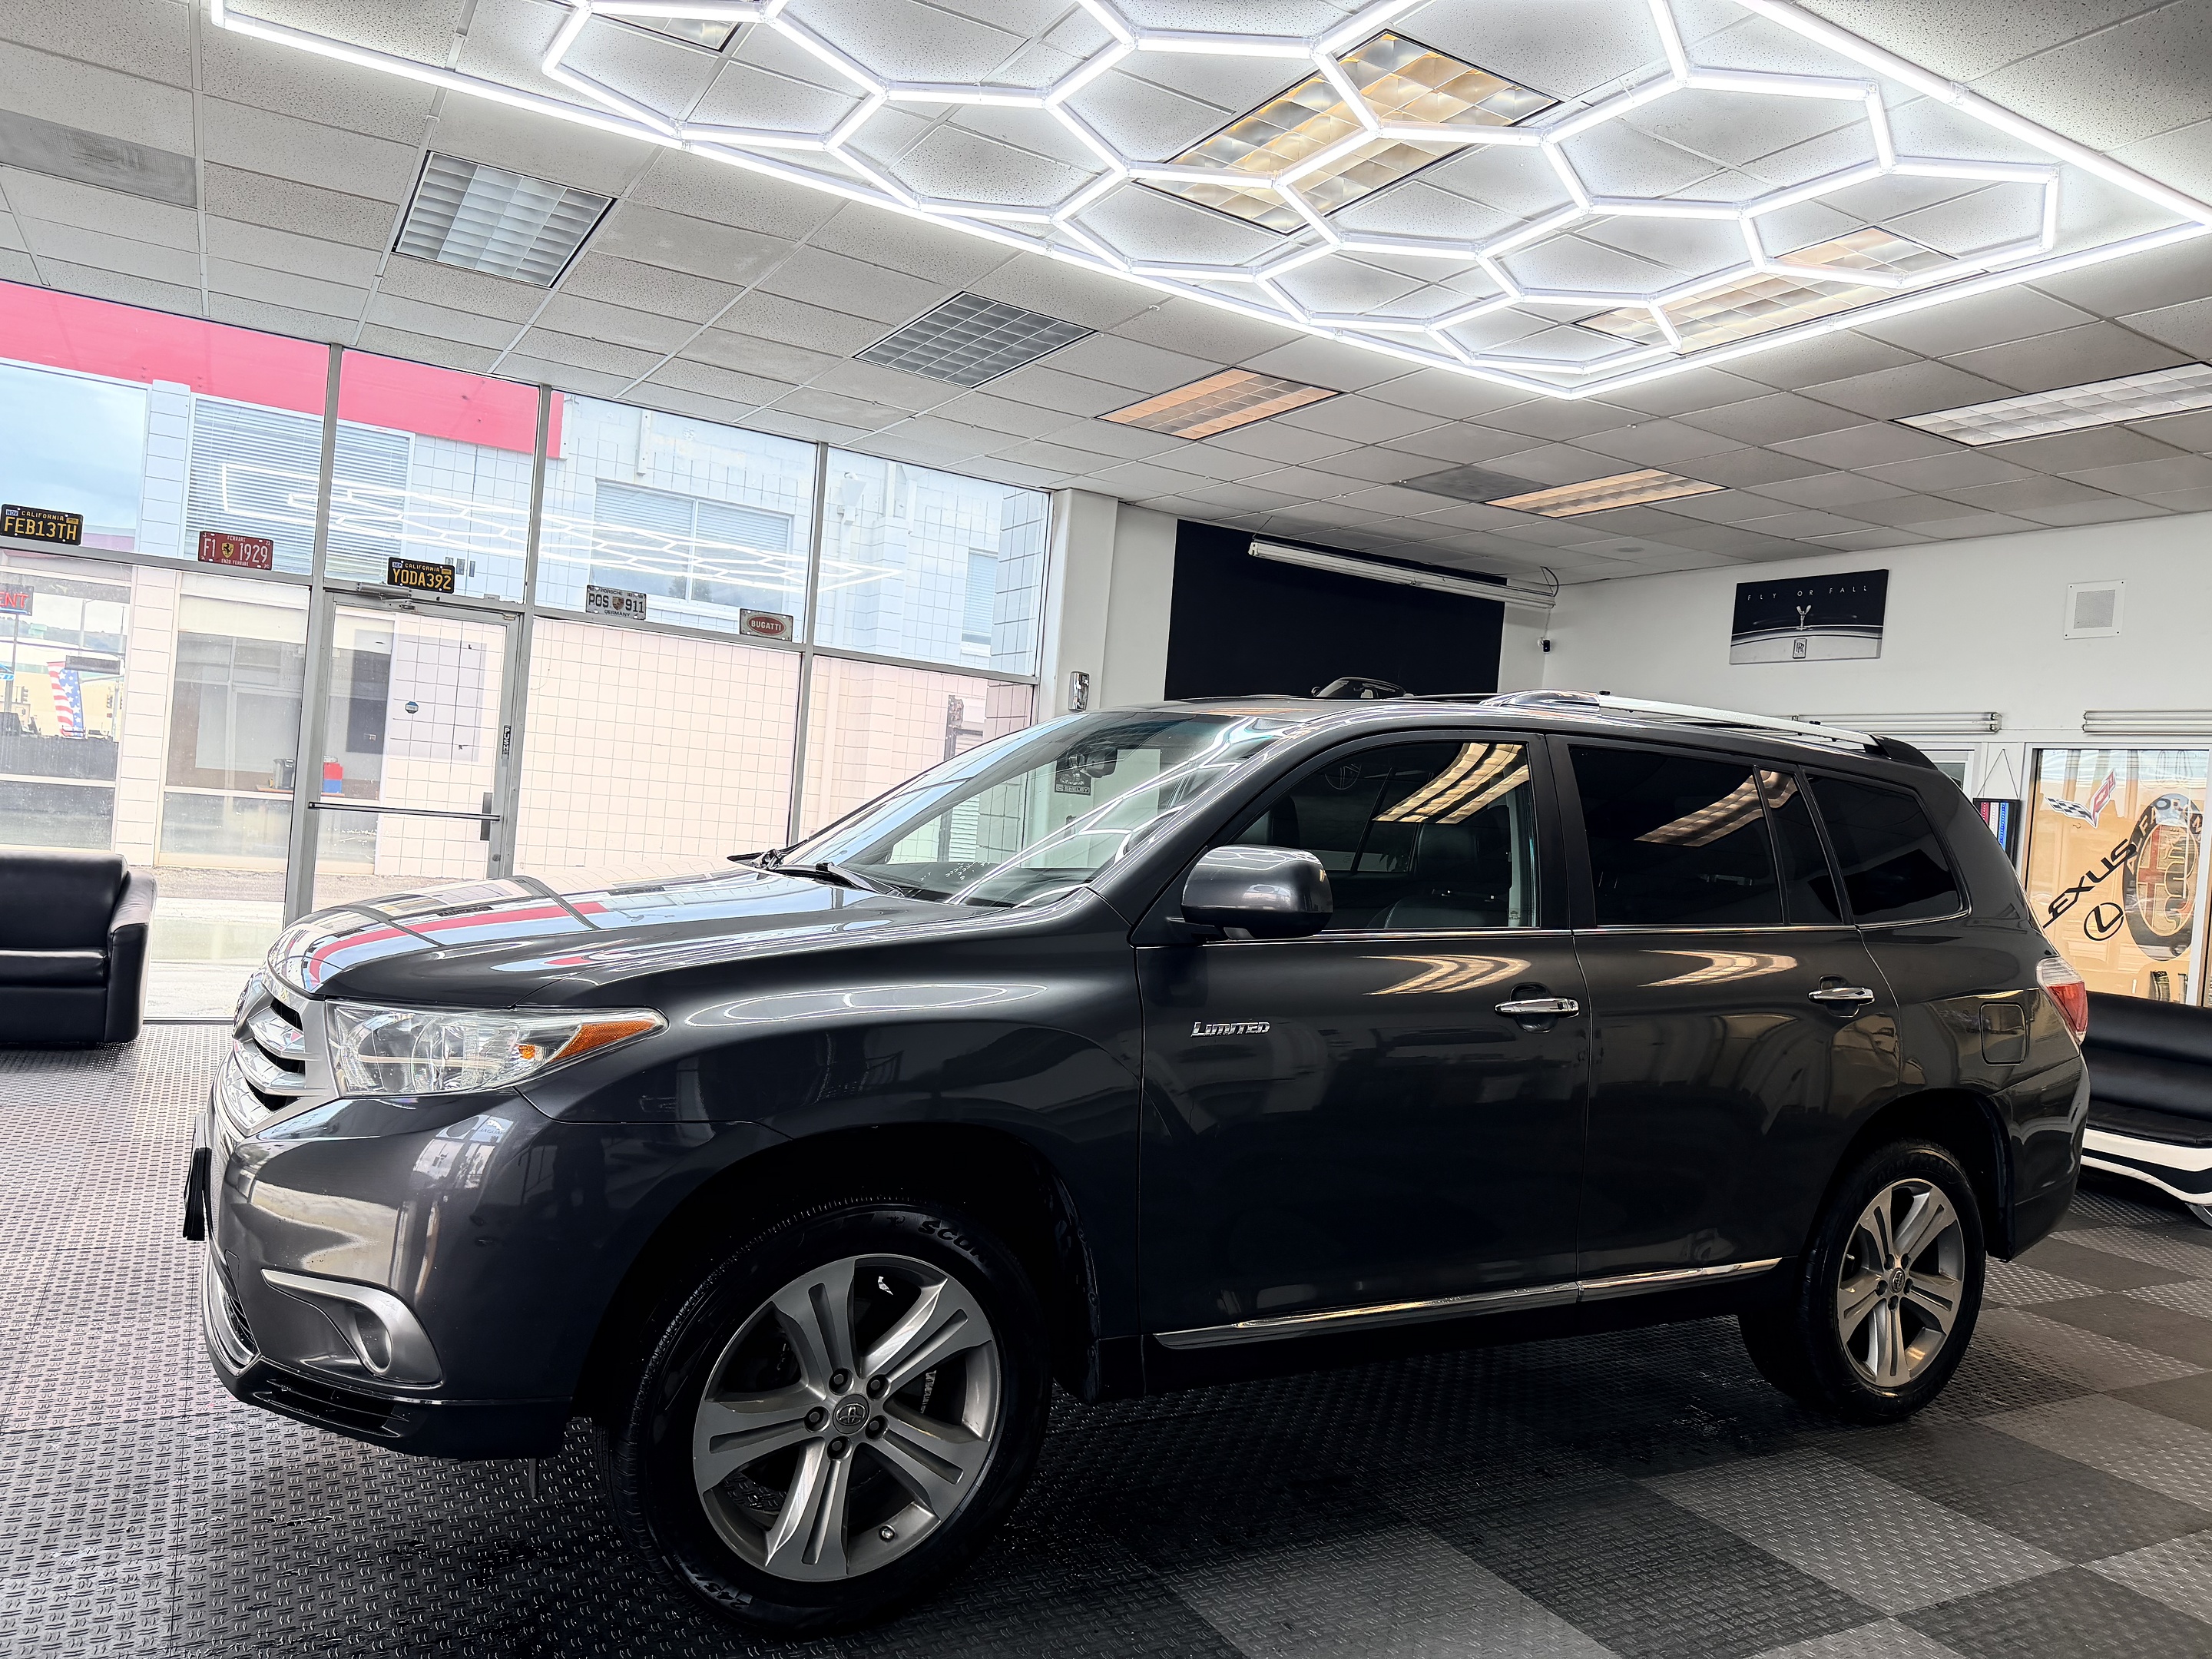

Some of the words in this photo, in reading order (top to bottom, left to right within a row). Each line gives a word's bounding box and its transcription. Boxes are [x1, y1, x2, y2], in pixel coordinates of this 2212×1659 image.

[22, 511, 64, 522] CALIFORNIA
[4, 516, 77, 541] FEB13TH
[204, 538, 216, 557] F1
[240, 543, 268, 563] 1929
[405, 563, 440, 572] CALIFORNIA
[392, 568, 452, 590] YODA392
[1829, 585, 1867, 594] FALL
[625, 598, 644, 613] 911
[751, 620, 782, 631] BUGATTI
[2043, 839, 2137, 929] EXUS
